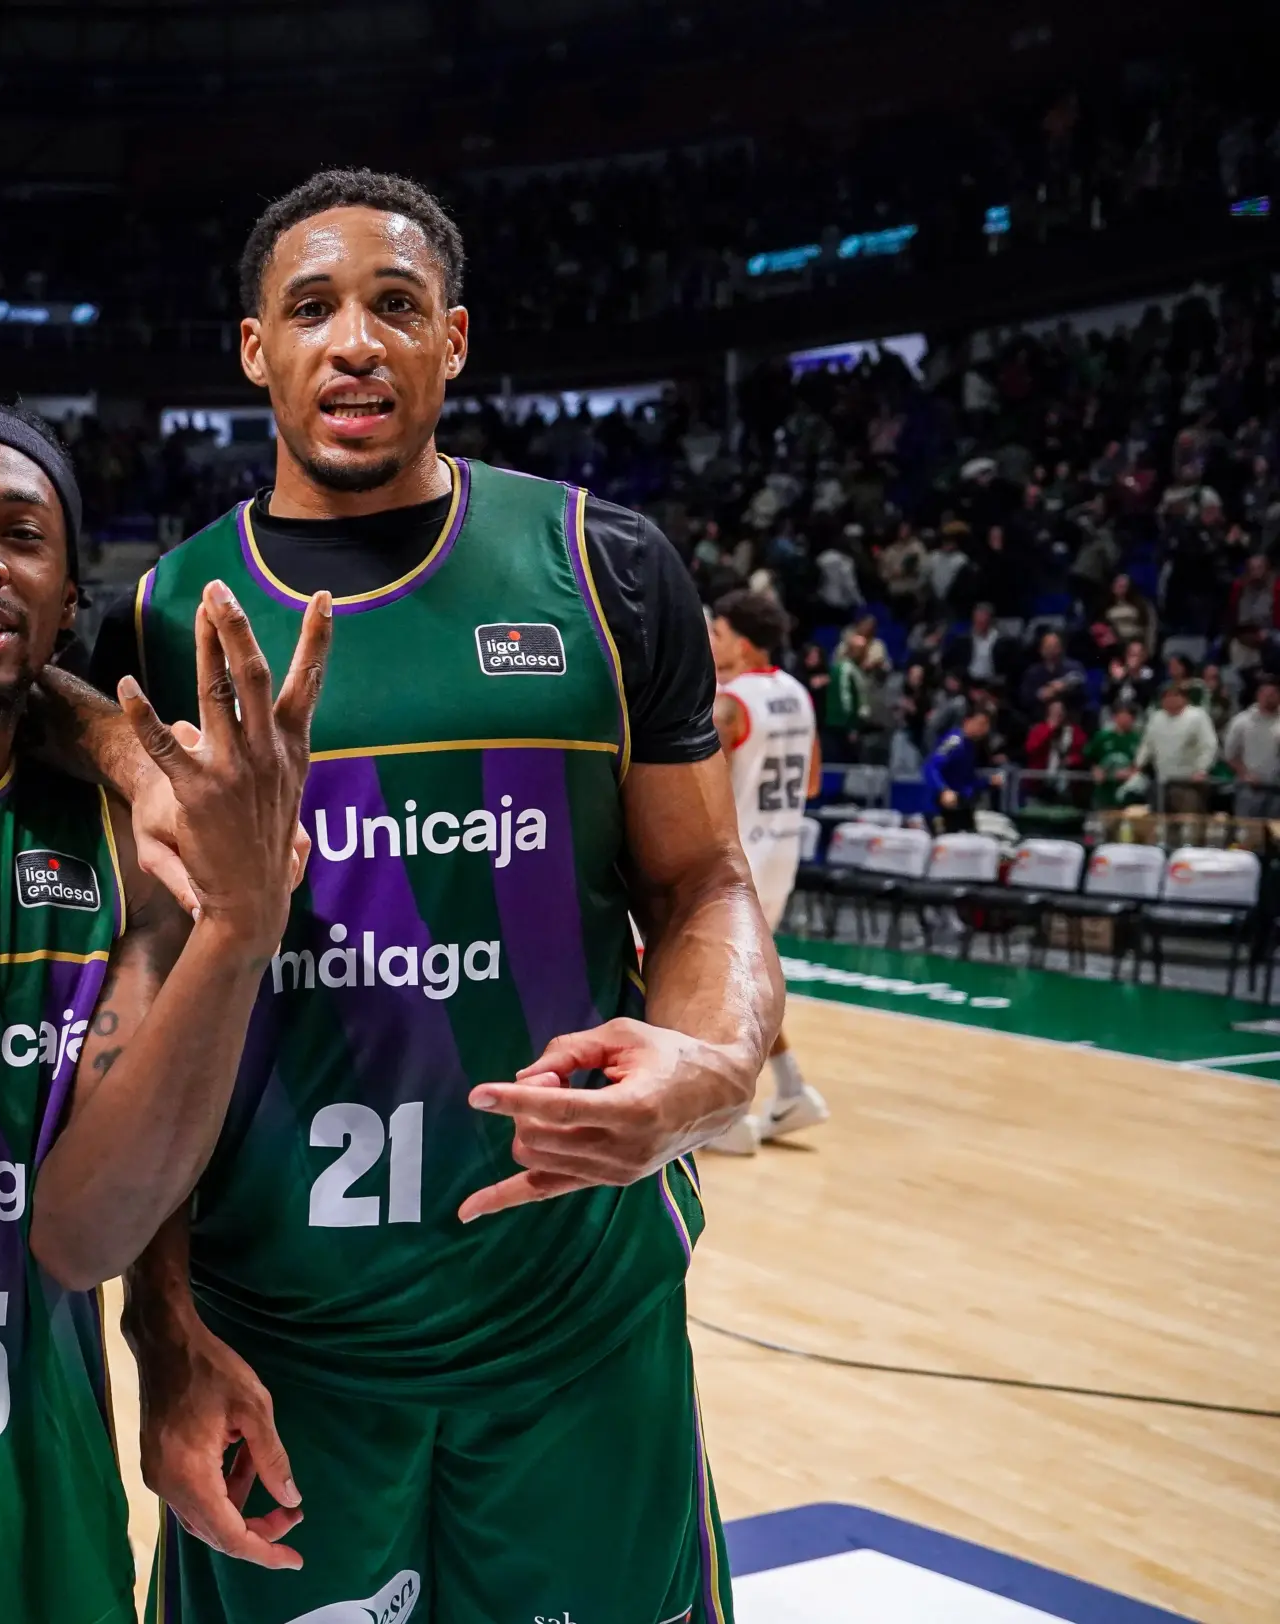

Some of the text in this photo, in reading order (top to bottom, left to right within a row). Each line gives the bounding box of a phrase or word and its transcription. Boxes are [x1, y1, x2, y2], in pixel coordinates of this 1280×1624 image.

[487, 639, 520, 655] liga
[490, 652, 560, 667] endesa
[758, 754, 805, 811] 22
[315, 795, 548, 869] Unicaja
[25, 867, 58, 883] liga
[28, 882, 94, 902] endesa
[309, 1101, 424, 1228] 21
